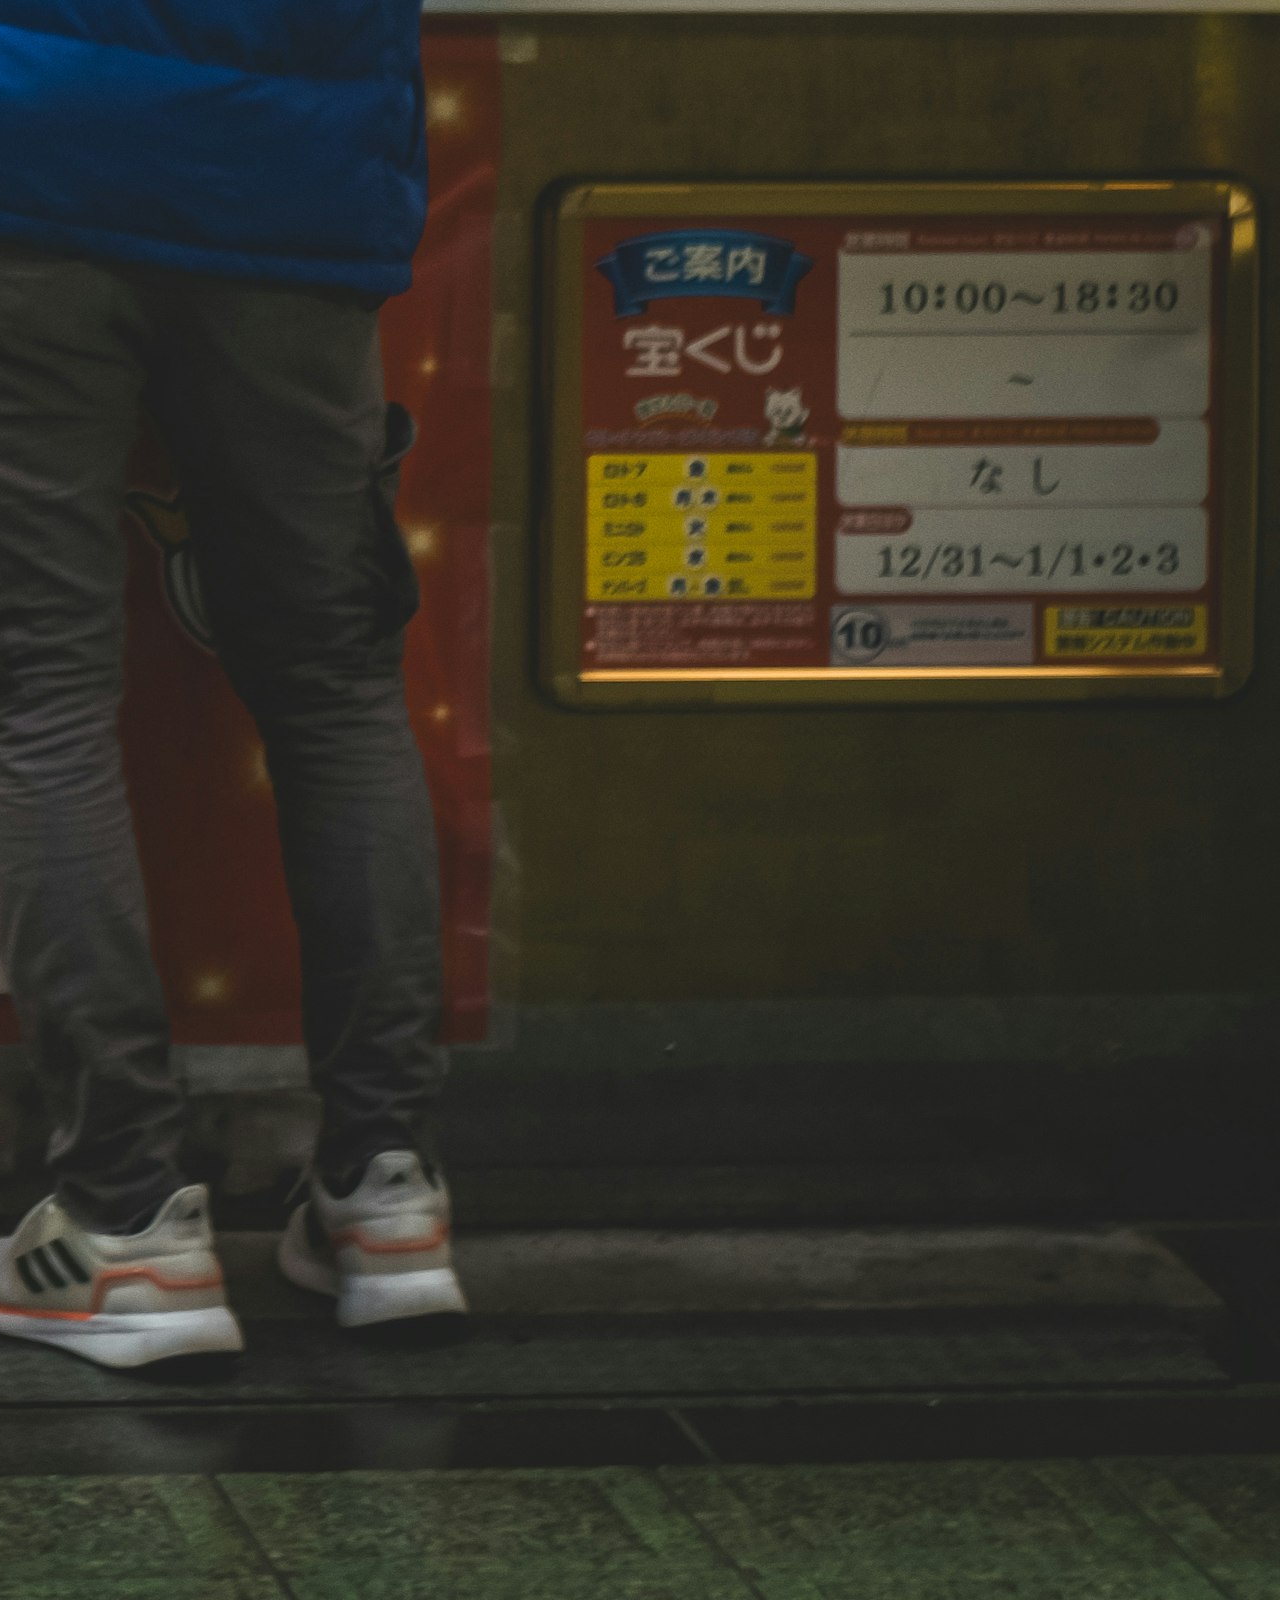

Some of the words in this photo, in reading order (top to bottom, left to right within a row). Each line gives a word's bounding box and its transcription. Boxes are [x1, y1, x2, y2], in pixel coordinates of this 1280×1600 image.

[643, 243, 768, 285] ご案内
[622, 322, 785, 378] 宝くじ
